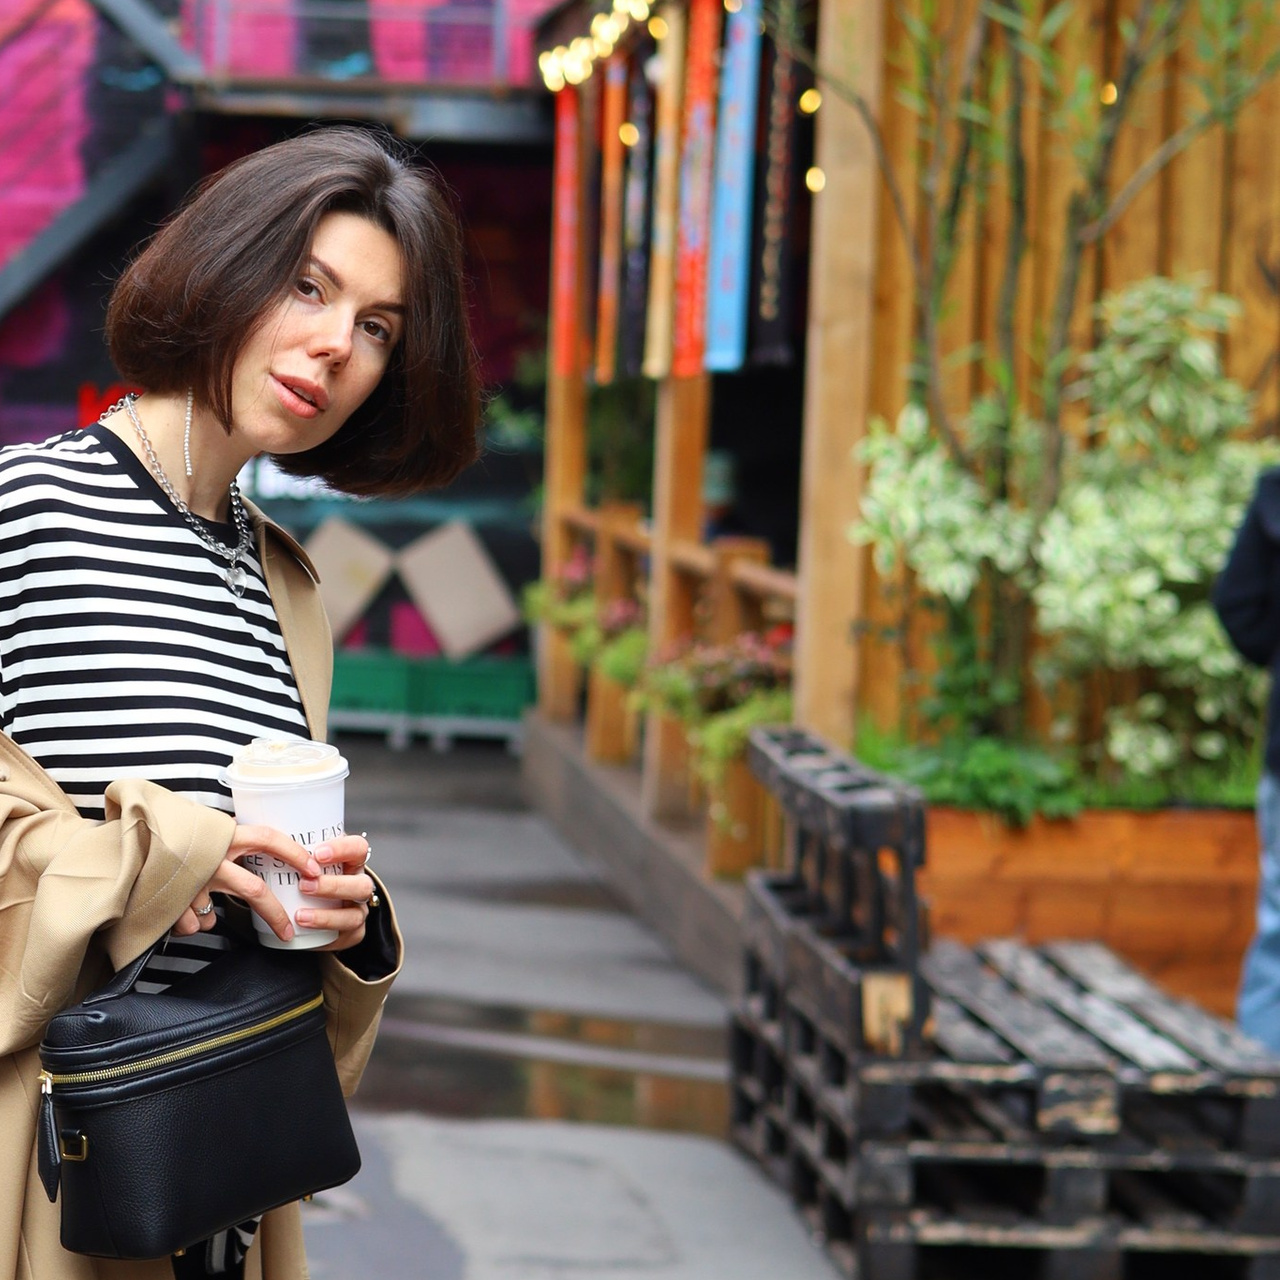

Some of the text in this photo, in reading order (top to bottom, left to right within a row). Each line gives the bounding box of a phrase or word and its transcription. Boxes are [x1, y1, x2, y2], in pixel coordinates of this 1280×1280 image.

[291, 821, 343, 845] ME EAS
[246, 854, 264, 867] EE
[323, 863, 342, 875] EAS
